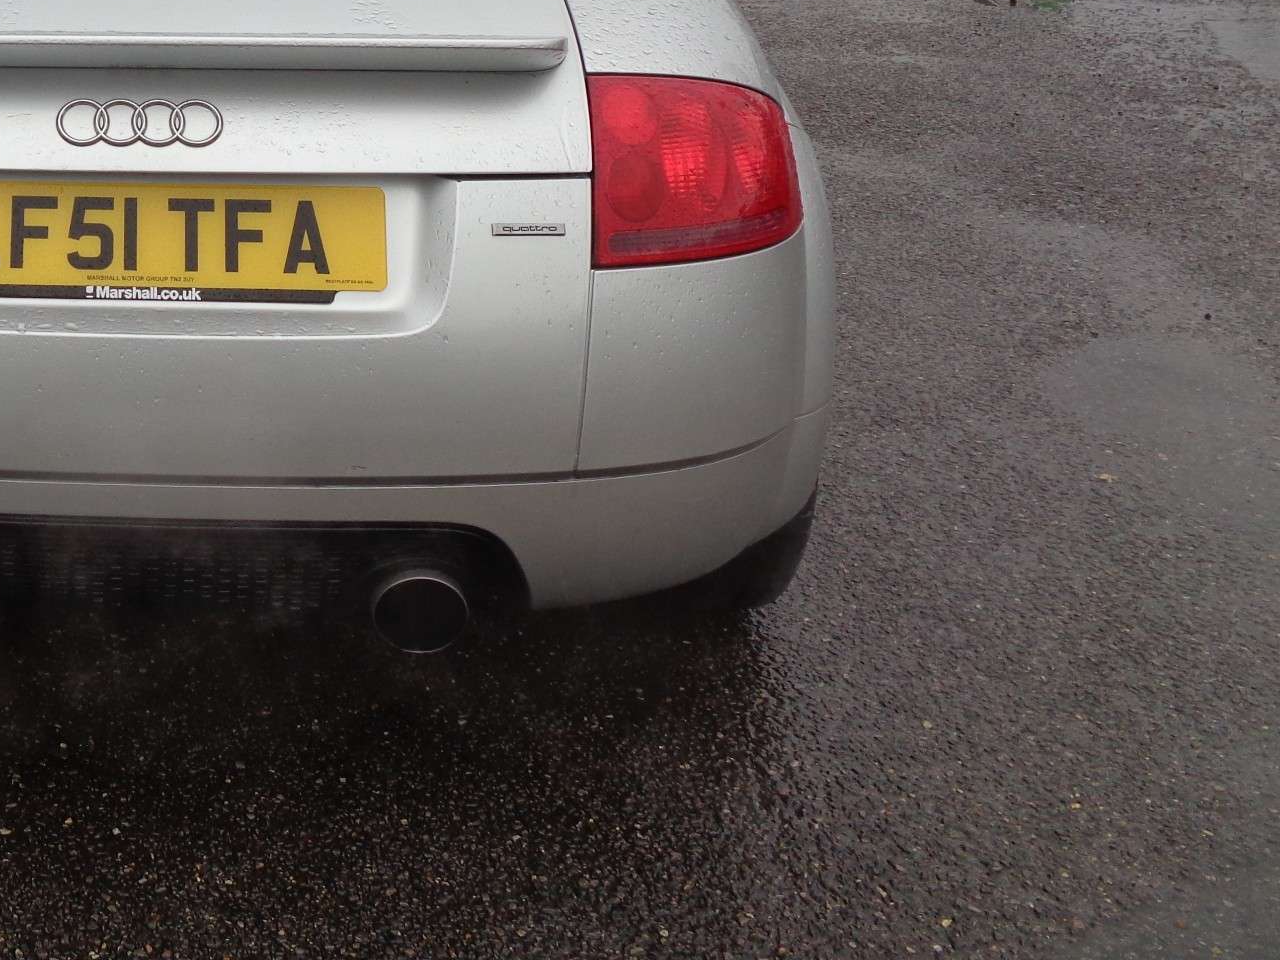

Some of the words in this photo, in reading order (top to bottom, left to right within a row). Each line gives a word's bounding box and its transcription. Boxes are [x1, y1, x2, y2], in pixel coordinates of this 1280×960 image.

[167, 198, 330, 275] TFA
[502, 225, 558, 233] quattro
[95, 285, 202, 301] Marshall.co.uk
